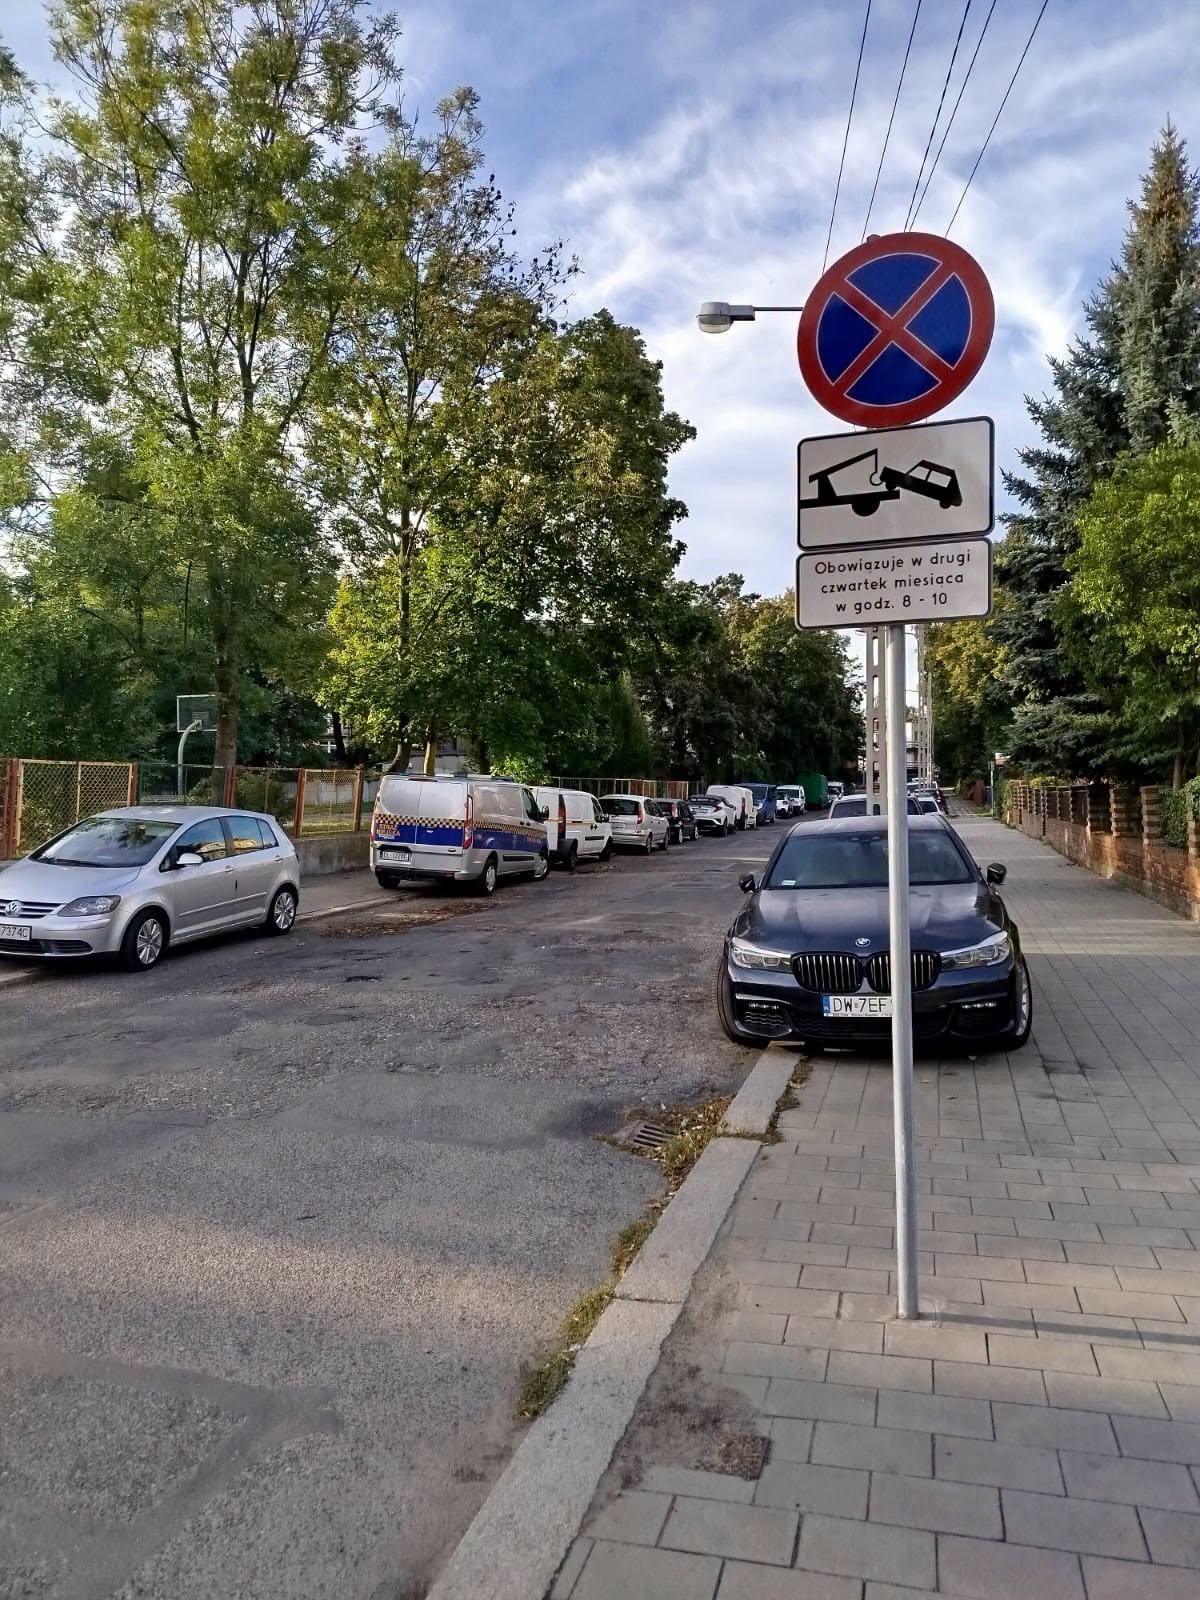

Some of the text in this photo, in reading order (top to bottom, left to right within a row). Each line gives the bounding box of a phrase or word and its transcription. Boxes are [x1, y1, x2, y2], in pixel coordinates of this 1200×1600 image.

[815, 549, 971, 574] Obowiązuje w drugi
[821, 572, 964, 594] czwartek miesiąca
[836, 602, 847, 612] w
[854, 597, 895, 614] godz.
[902, 594, 911, 607] 8
[932, 592, 948, 605] 10
[833, 998, 892, 1012] DW 7EF
